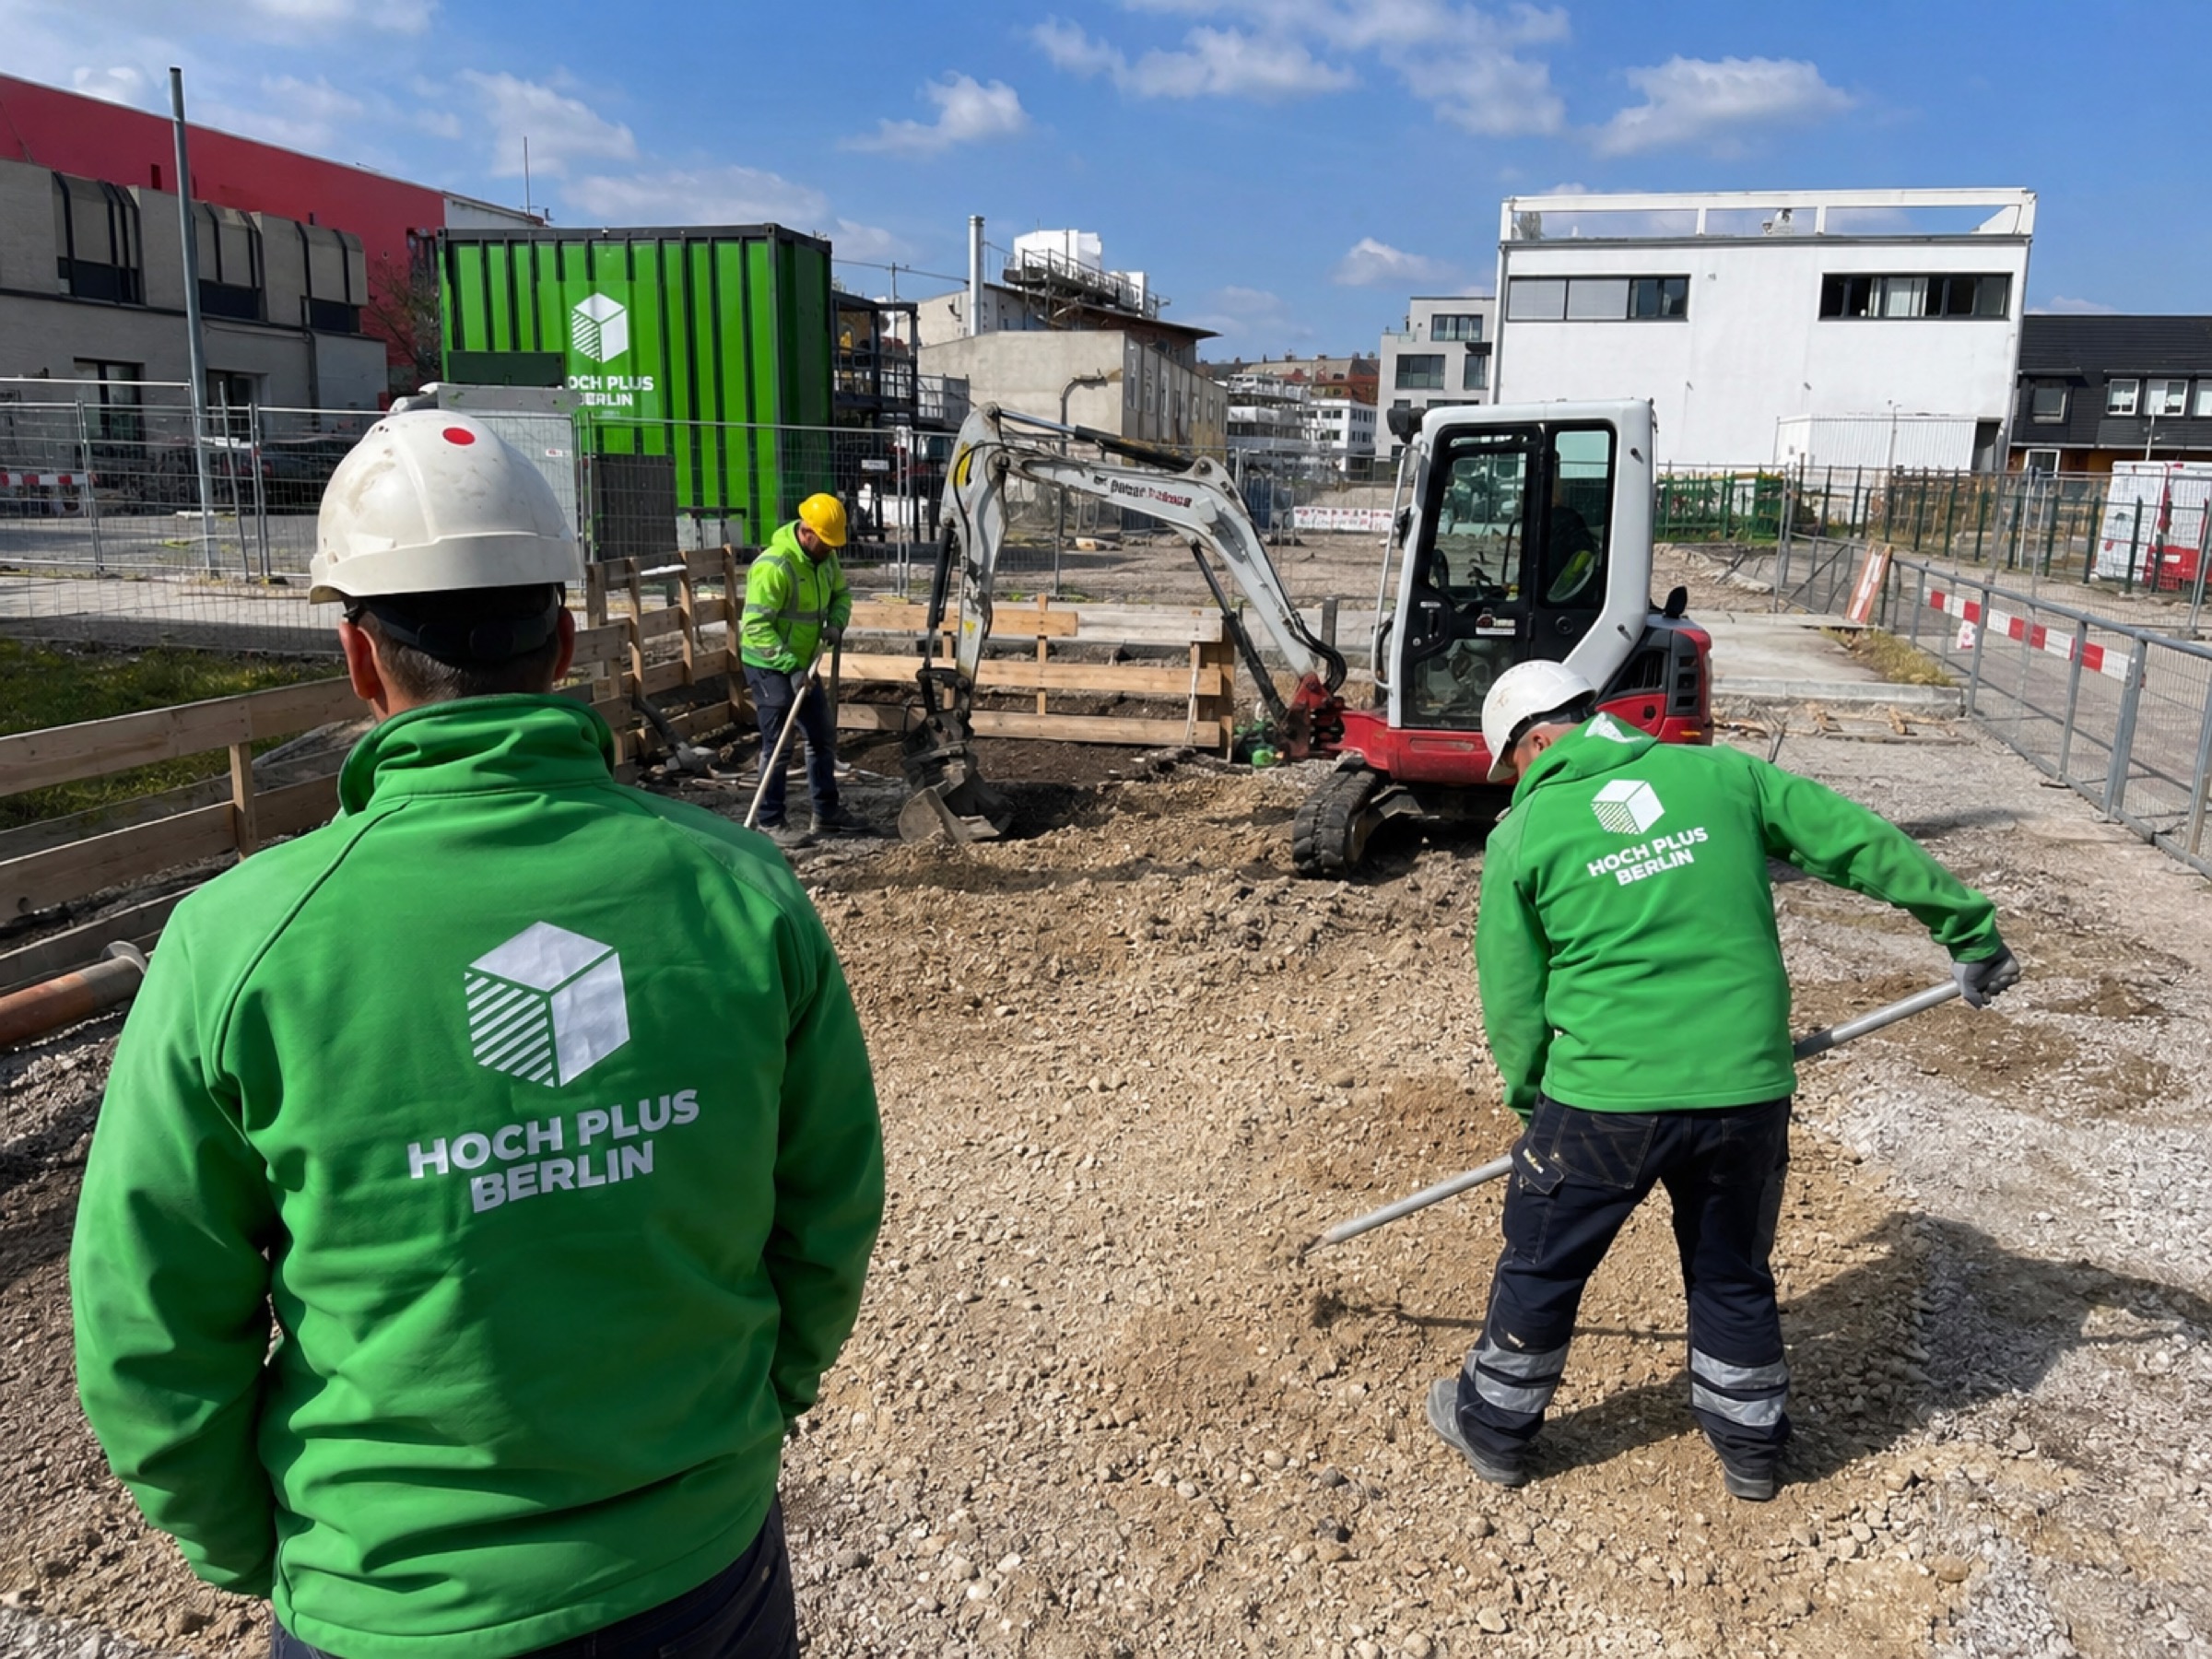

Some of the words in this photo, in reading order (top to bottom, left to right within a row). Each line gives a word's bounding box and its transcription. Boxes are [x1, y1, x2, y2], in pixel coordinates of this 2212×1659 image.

[558, 375, 602, 390] OCH
[606, 375, 653, 391] PLUS
[579, 392, 633, 406] ERLIN
[1587, 843, 1650, 877] HOCH
[1652, 827, 1709, 854] PLUS
[1615, 848, 1694, 886] BERLIN
[407, 1116, 563, 1179] HOCH
[577, 1089, 700, 1147] PLUS
[470, 1139, 653, 1213] BERLIN
